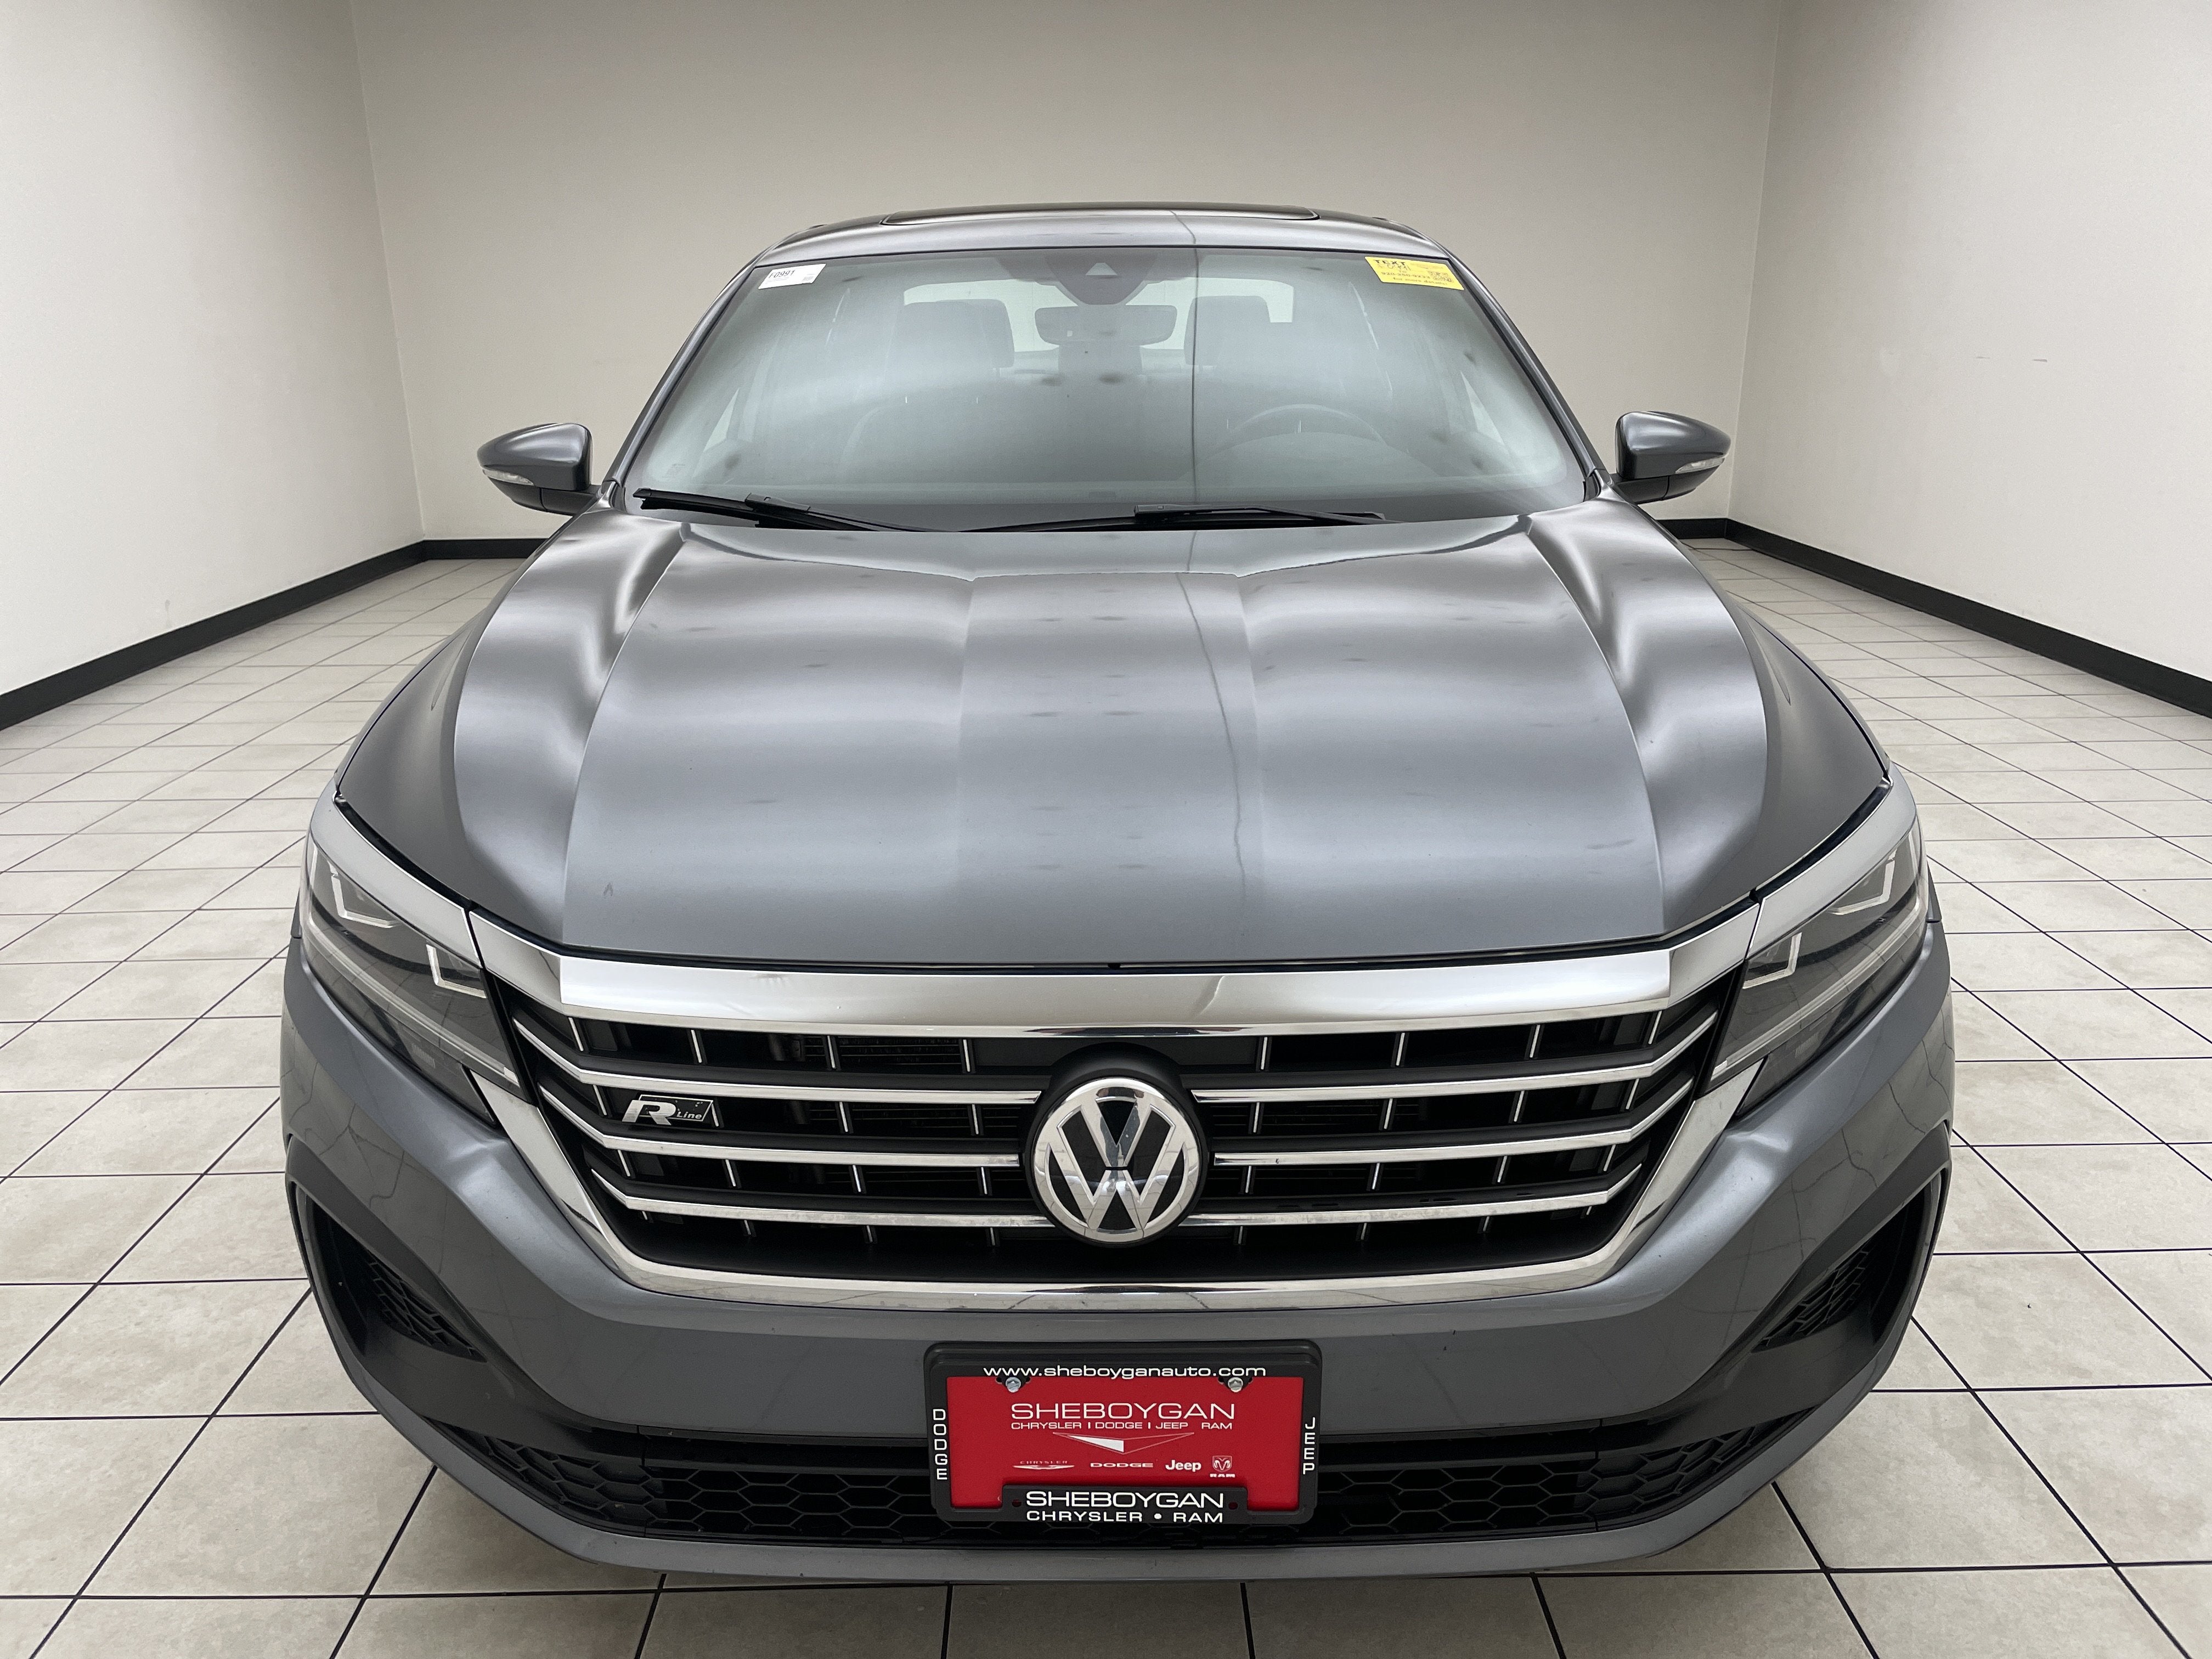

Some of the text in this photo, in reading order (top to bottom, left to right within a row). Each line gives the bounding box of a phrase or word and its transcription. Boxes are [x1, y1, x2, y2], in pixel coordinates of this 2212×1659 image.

[769, 270, 795, 279] F0991
[676, 1111, 702, 1120] Line
[983, 1365, 1266, 1380] www.sheboyganauto.com
[1011, 1402, 1235, 1420] SHEBOYGAN
[1011, 1421, 1082, 1430] CHRYSLER
[1095, 1421, 1143, 1430] DODGE
[1155, 1421, 1188, 1430] JEEP
[1201, 1421, 1233, 1430] RAM
[933, 1408, 948, 1480] DODGE
[1302, 1417, 1316, 1475] JEEP
[1165, 1459, 1202, 1472] Jeep
[1026, 1491, 1224, 1508] SHEBOYGAN
[1026, 1510, 1223, 1523] CHRYSLER RAM
